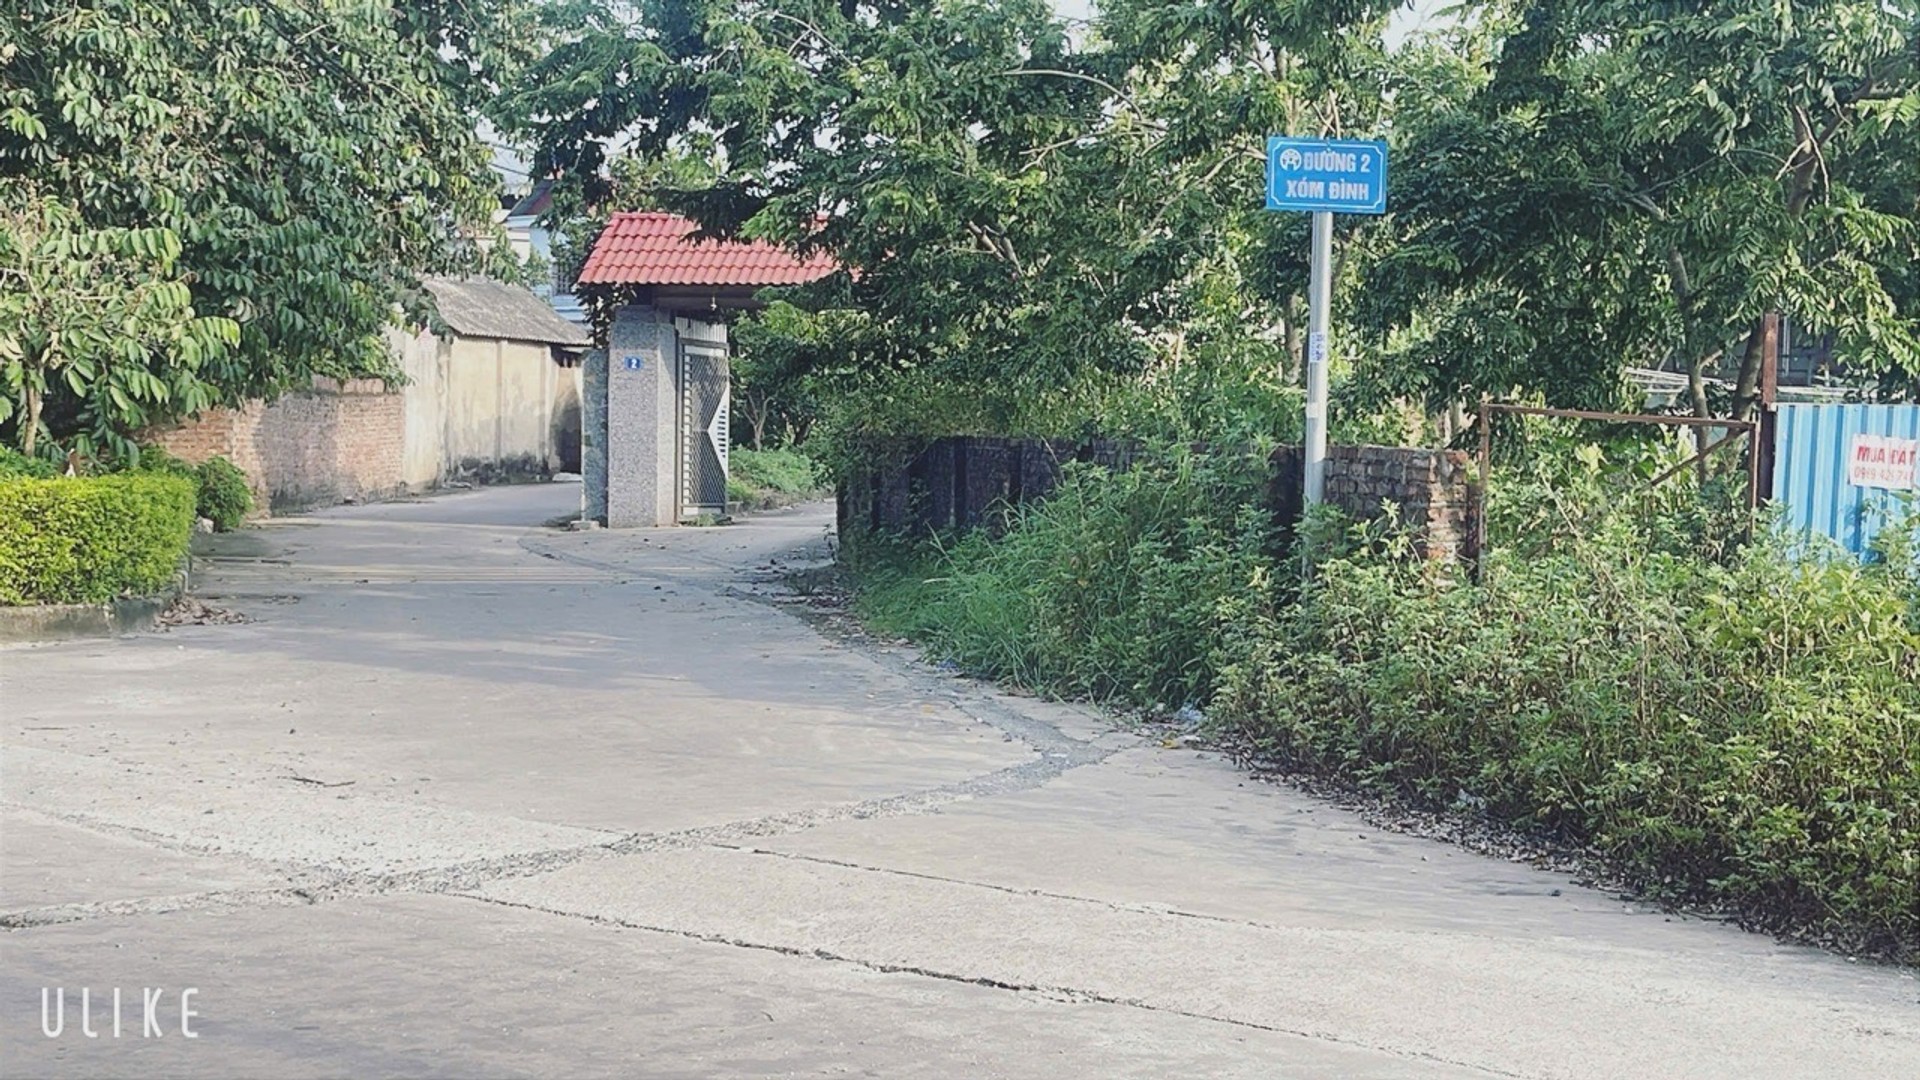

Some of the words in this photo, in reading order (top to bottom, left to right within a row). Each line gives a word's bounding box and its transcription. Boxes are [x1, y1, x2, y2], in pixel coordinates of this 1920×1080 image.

[1303, 149, 1356, 172] ĐƯỜNG
[1360, 154, 1371, 173] 2
[1286, 177, 1324, 199] XÓM
[1329, 178, 1369, 200] ĐÌNH
[631, 358, 637, 369] 2
